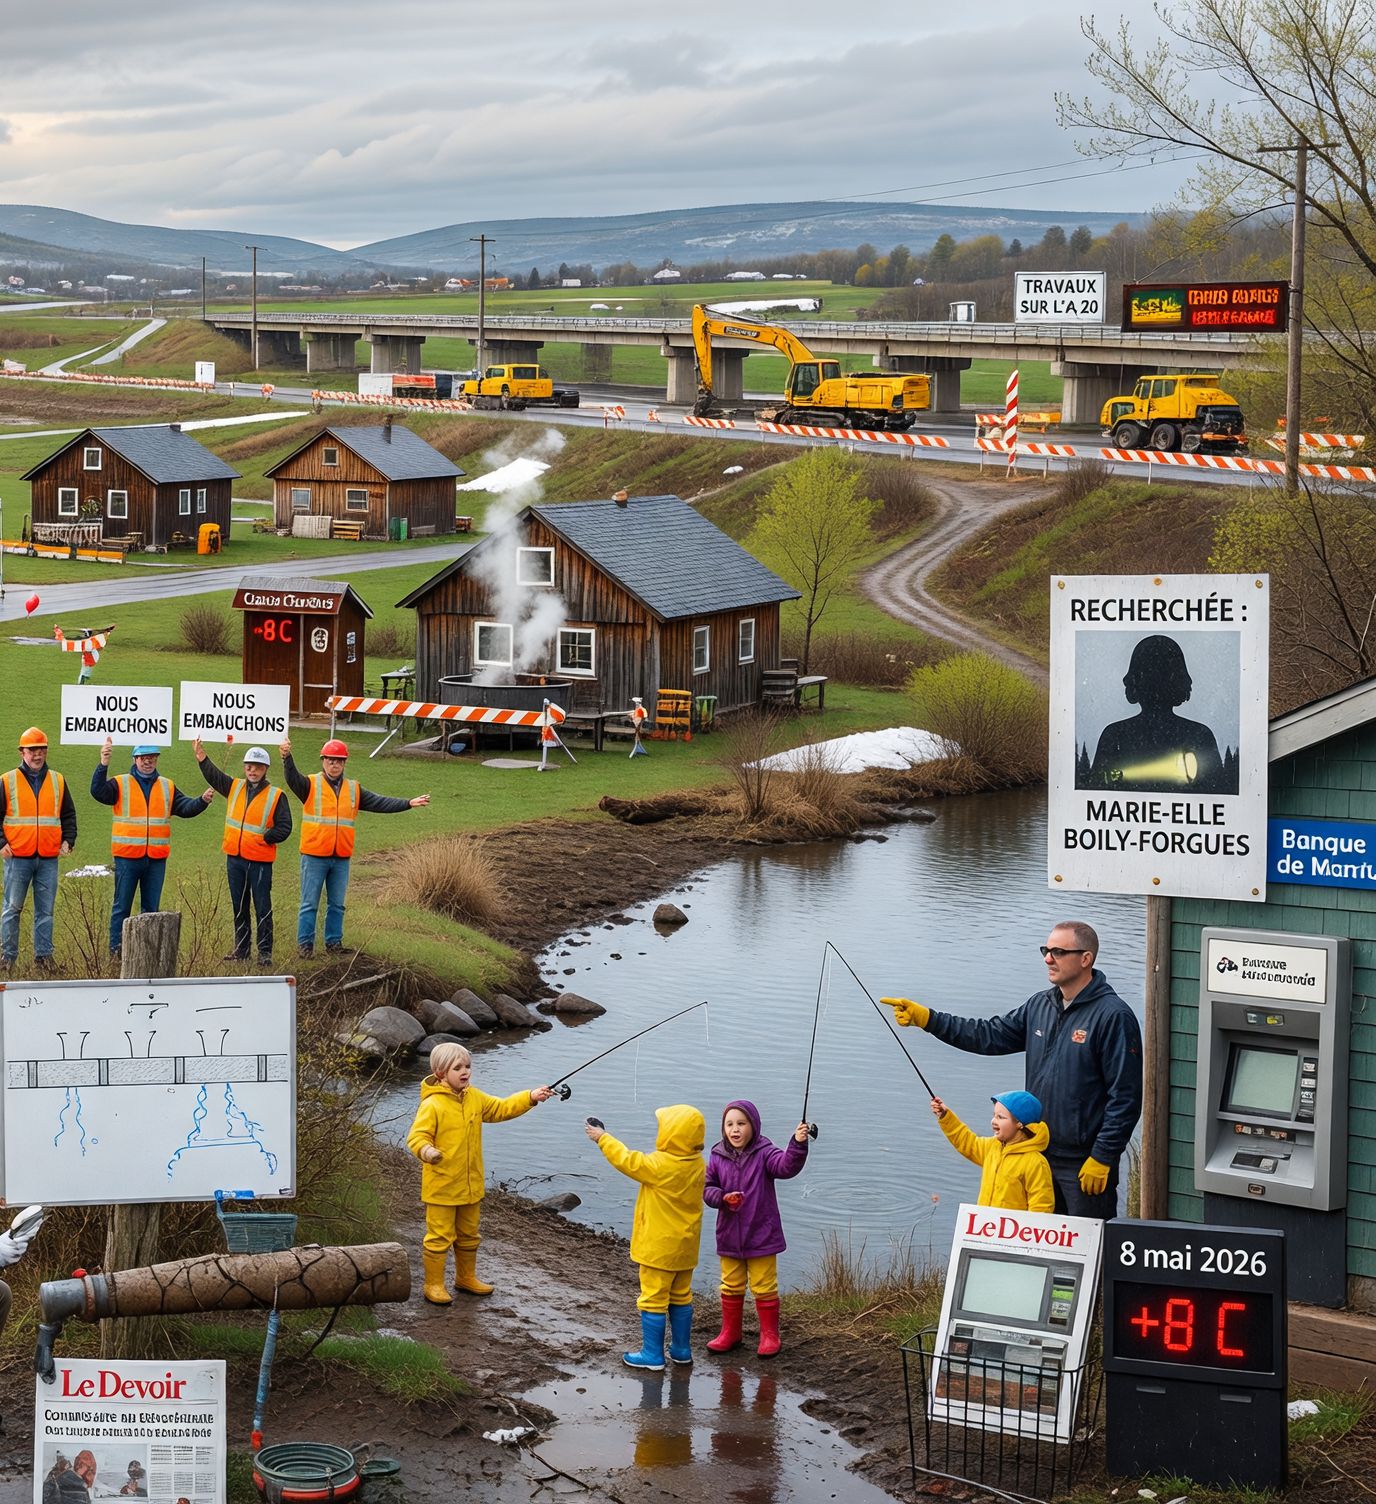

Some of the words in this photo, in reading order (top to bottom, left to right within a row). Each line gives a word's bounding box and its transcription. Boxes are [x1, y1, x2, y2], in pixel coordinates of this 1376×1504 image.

[1023, 279, 1097, 294] TRAVAUX
[1020, 300, 1049, 314] SUR
[1081, 300, 1099, 314] 20
[1071, 592, 1234, 622] RECHERCHÉE
[1241, 604, 1248, 622] :
[96, 696, 139, 712] NOUS
[212, 693, 256, 710] NOUS
[65, 716, 168, 734] EMBAUCHONS
[183, 712, 285, 733] EMBAUCHONS
[1085, 800, 1226, 826] MARIE-ELLE
[1064, 828, 1250, 857] BOILY-FORGUES
[1282, 829, 1366, 856] Banque
[1277, 854, 1304, 875] de
[965, 1213, 996, 1237] Le
[998, 1215, 1079, 1248] Devoir
[1120, 1240, 1137, 1266] 8
[1144, 1244, 1192, 1271] mai
[1200, 1246, 1267, 1277] 2026
[1131, 1298, 1195, 1352] +8
[1217, 1302, 1246, 1357] C
[60, 1369, 95, 1397] Le
[98, 1370, 187, 1400] Devoir
